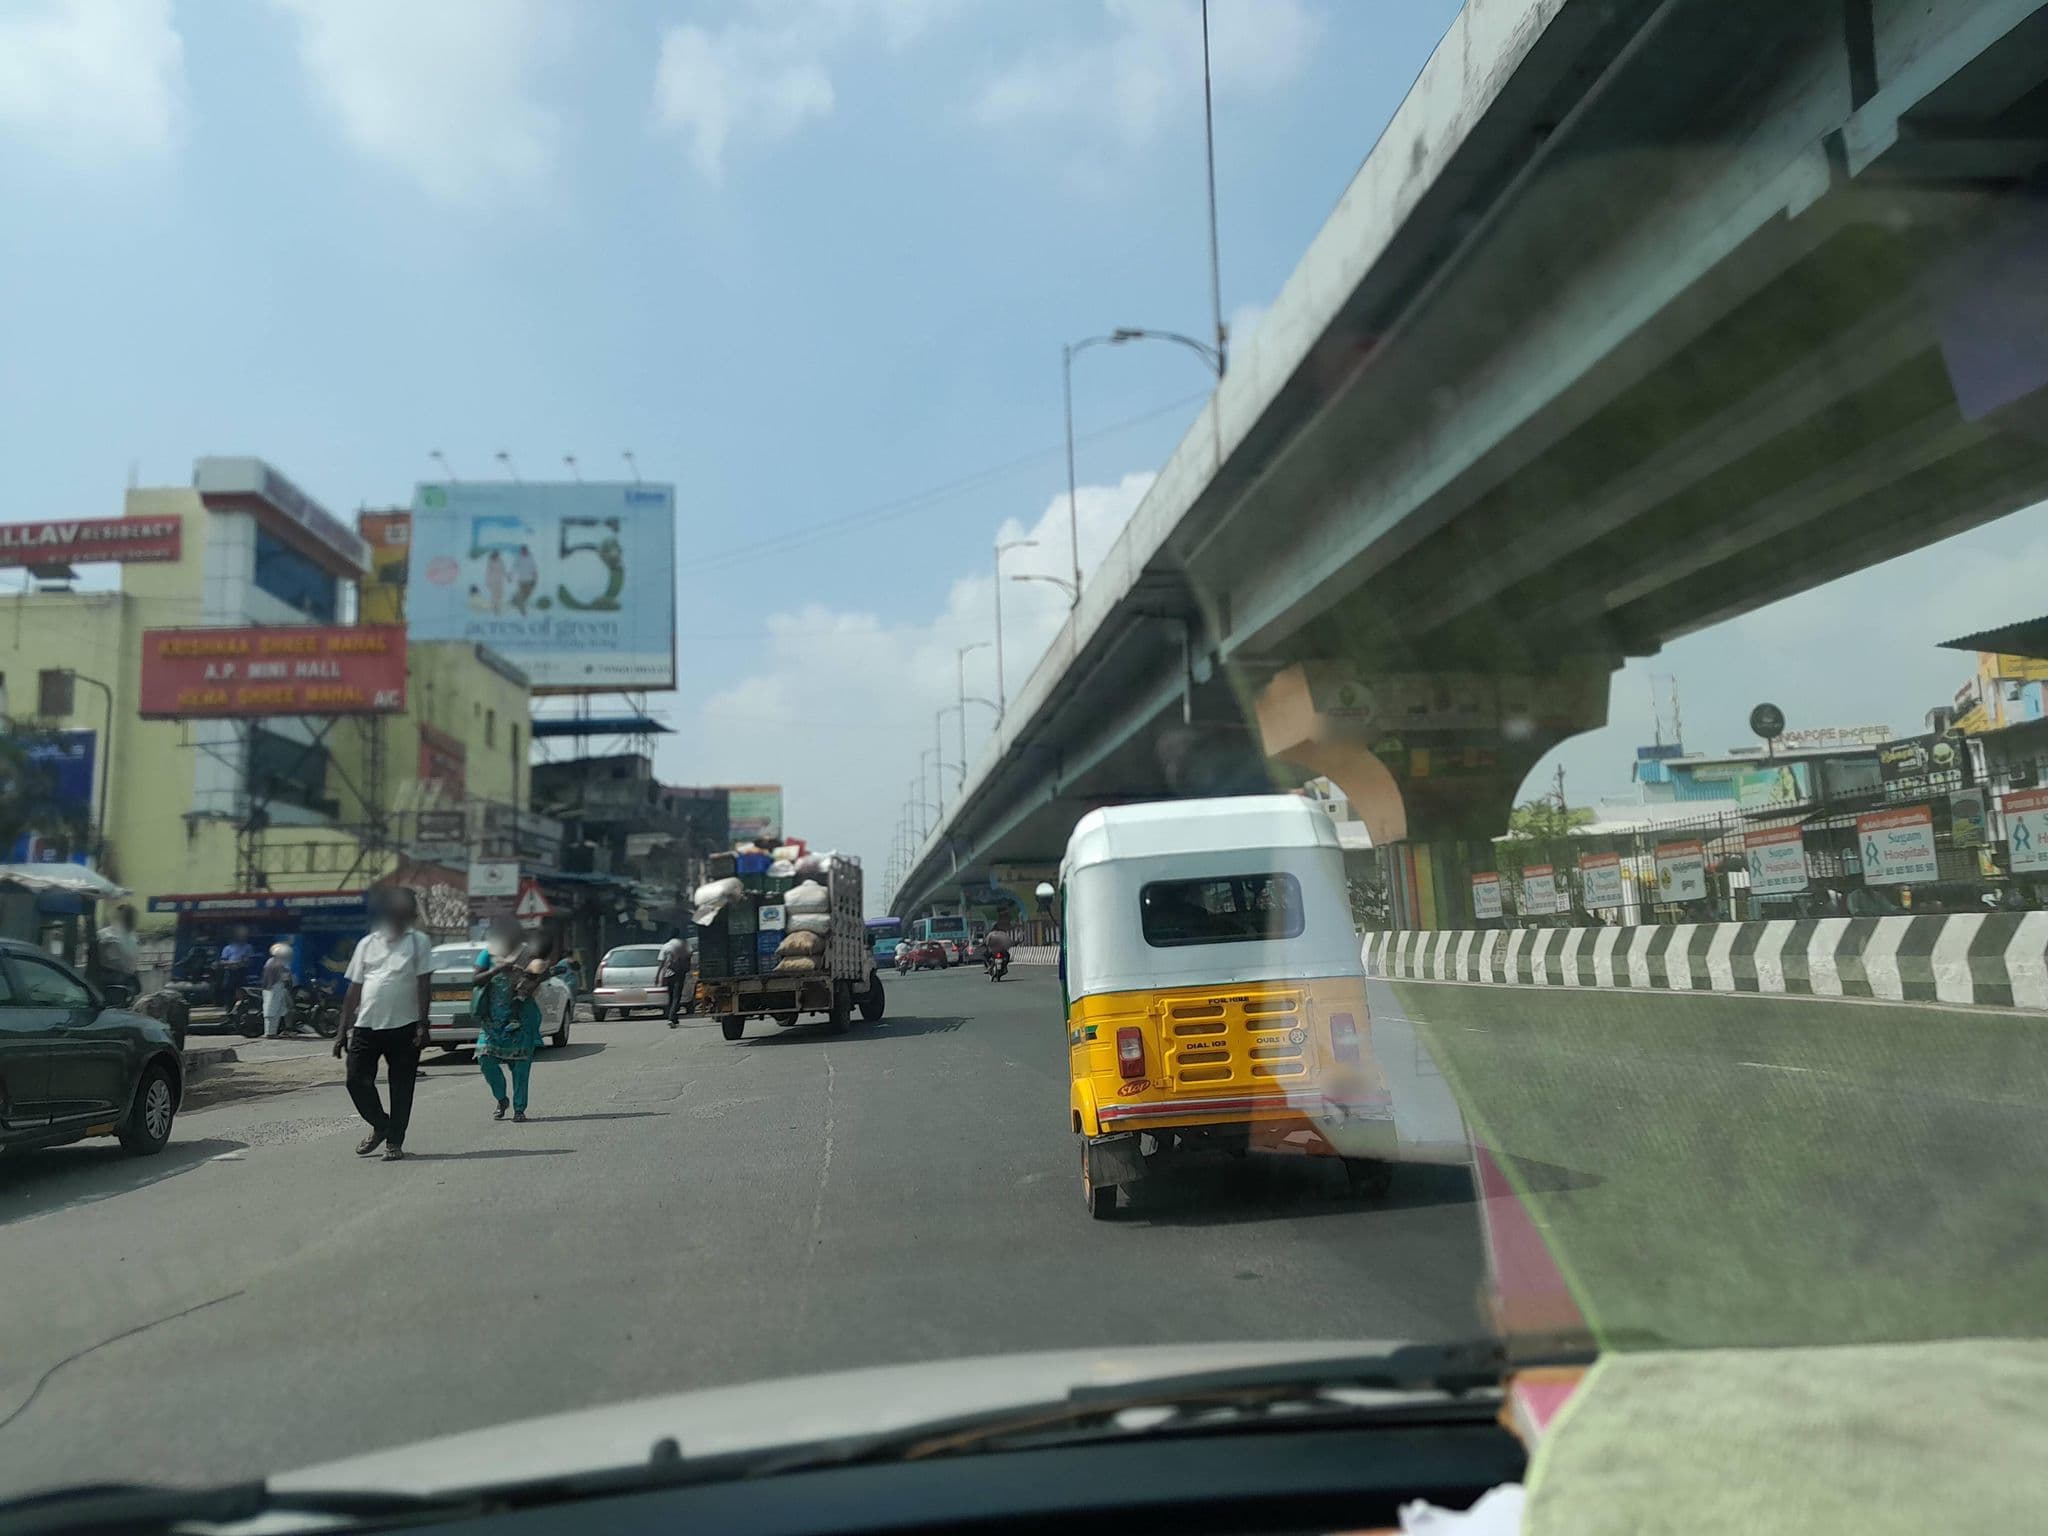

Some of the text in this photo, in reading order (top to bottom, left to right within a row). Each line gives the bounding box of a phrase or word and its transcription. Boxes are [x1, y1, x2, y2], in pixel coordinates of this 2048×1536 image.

[0, 524, 79, 548] LLAV
[248, 662, 287, 678] MINI
[295, 660, 341, 678] HALL
[1888, 831, 1922, 846] Sugam
[1883, 845, 1930, 861] Hospitals
[1186, 1042, 1209, 1050] DIAL
